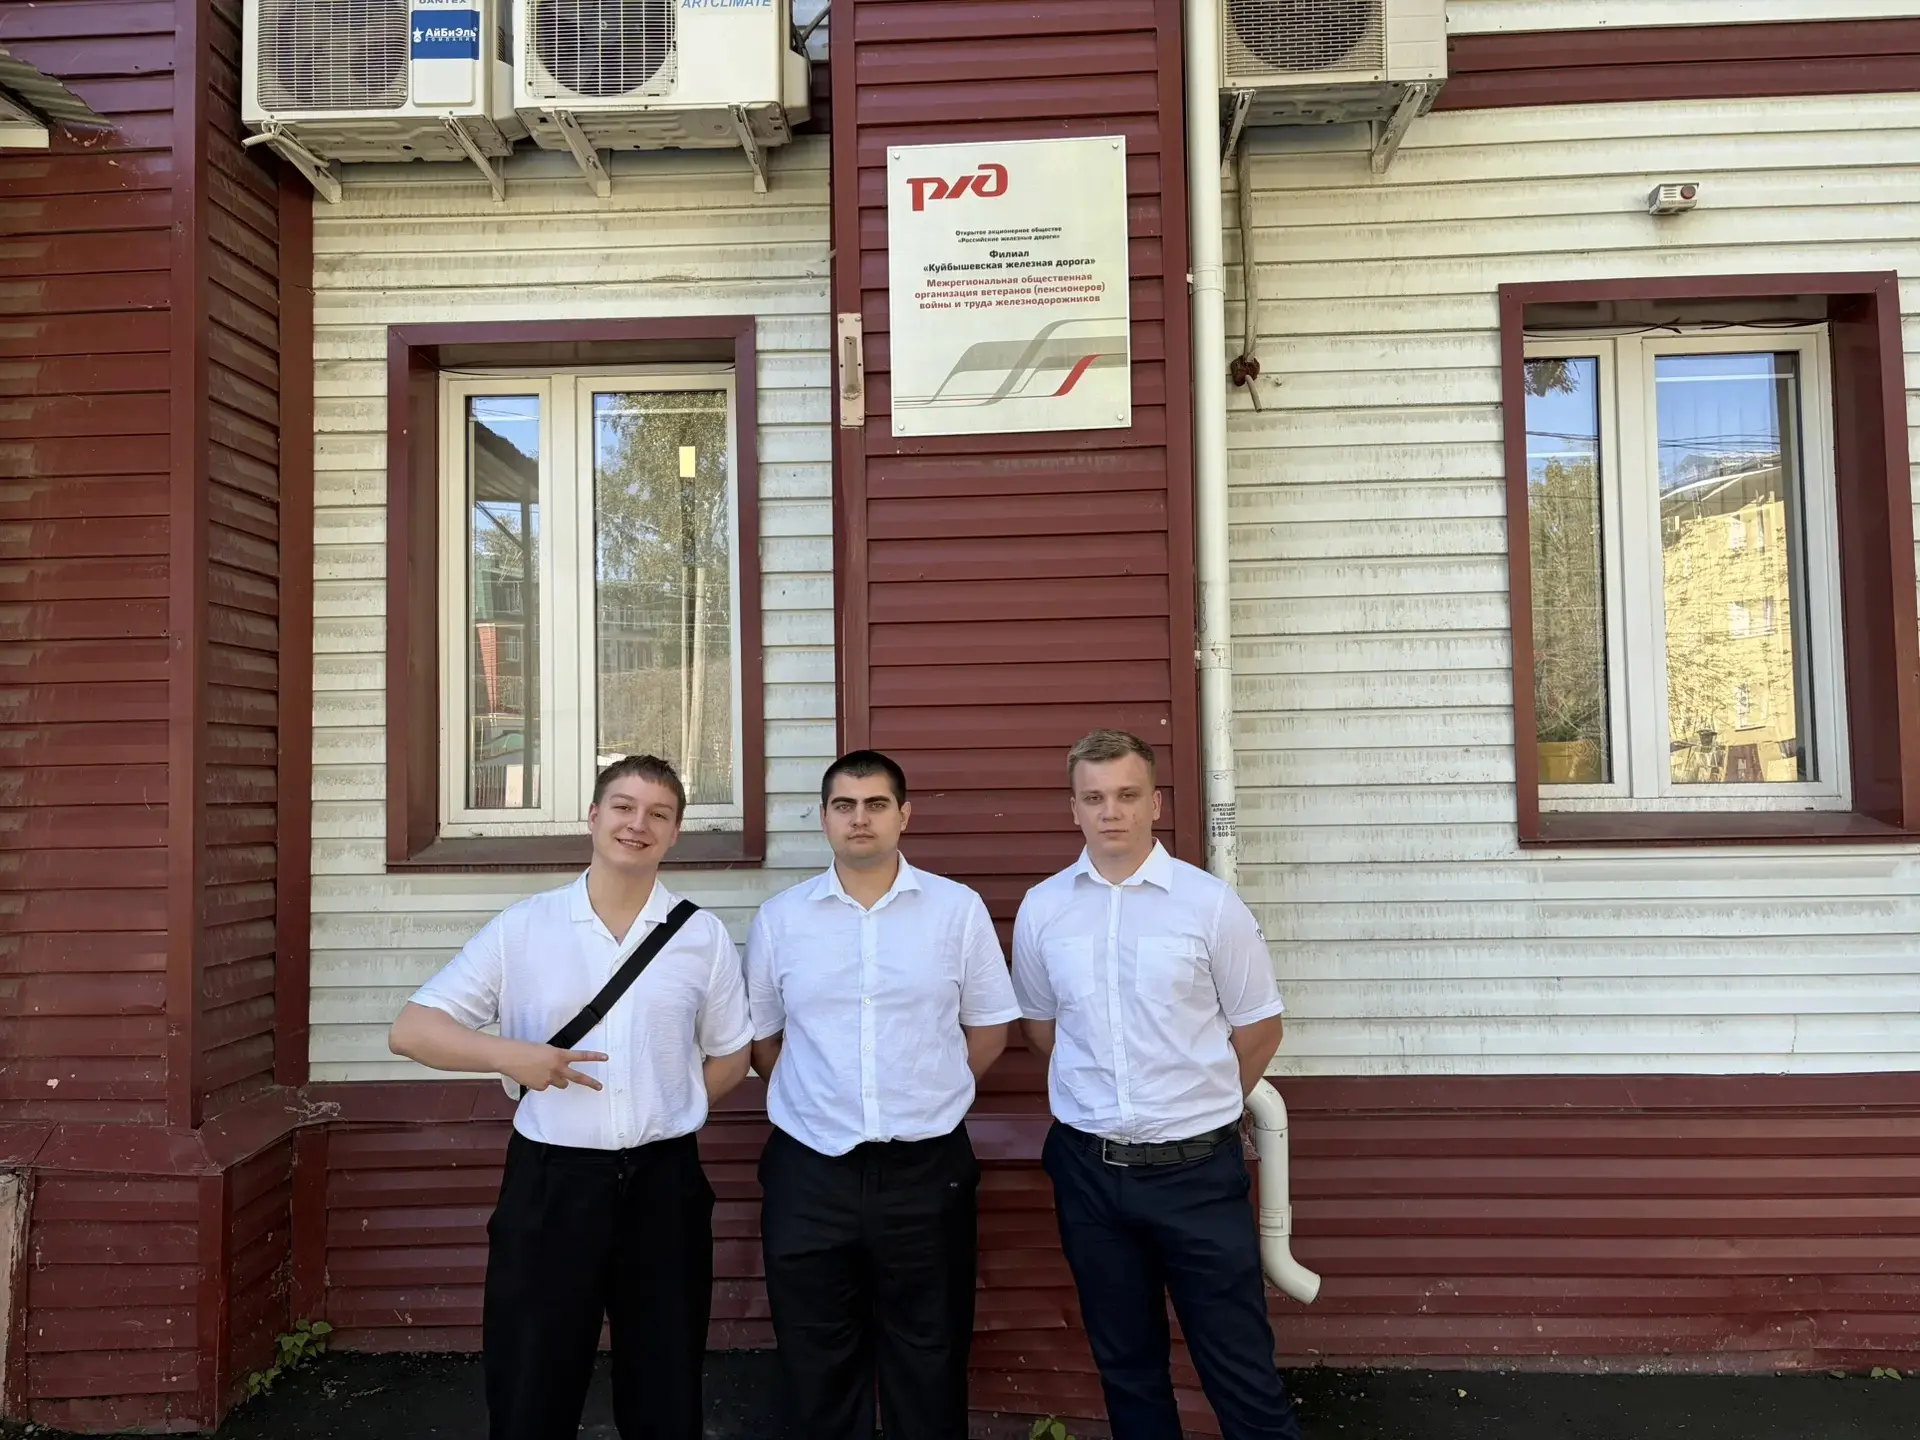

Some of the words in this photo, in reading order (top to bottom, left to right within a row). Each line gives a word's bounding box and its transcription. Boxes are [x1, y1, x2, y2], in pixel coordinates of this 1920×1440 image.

[955, 229, 987, 237] Открытое
[988, 227, 1030, 236] акционерное
[1031, 226, 1062, 234] общество
[957, 236, 999, 244] «Российские
[1033, 233, 1060, 242] дороги»
[989, 249, 1030, 259] Филиал
[923, 262, 1003, 273] «Куйбышевская
[1005, 260, 1053, 269] железная
[1055, 258, 1096, 269] дорога»
[926, 277, 1019, 289] Межрегиональная
[1021, 273, 1093, 285] общественная
[914, 290, 978, 300] организация
[981, 287, 1032, 297] ветеранов
[1034, 281, 1106, 296] (пенсионеров)
[919, 300, 952, 310] войны
[964, 299, 993, 309] труда
[995, 295, 1101, 307] железнодорожников
